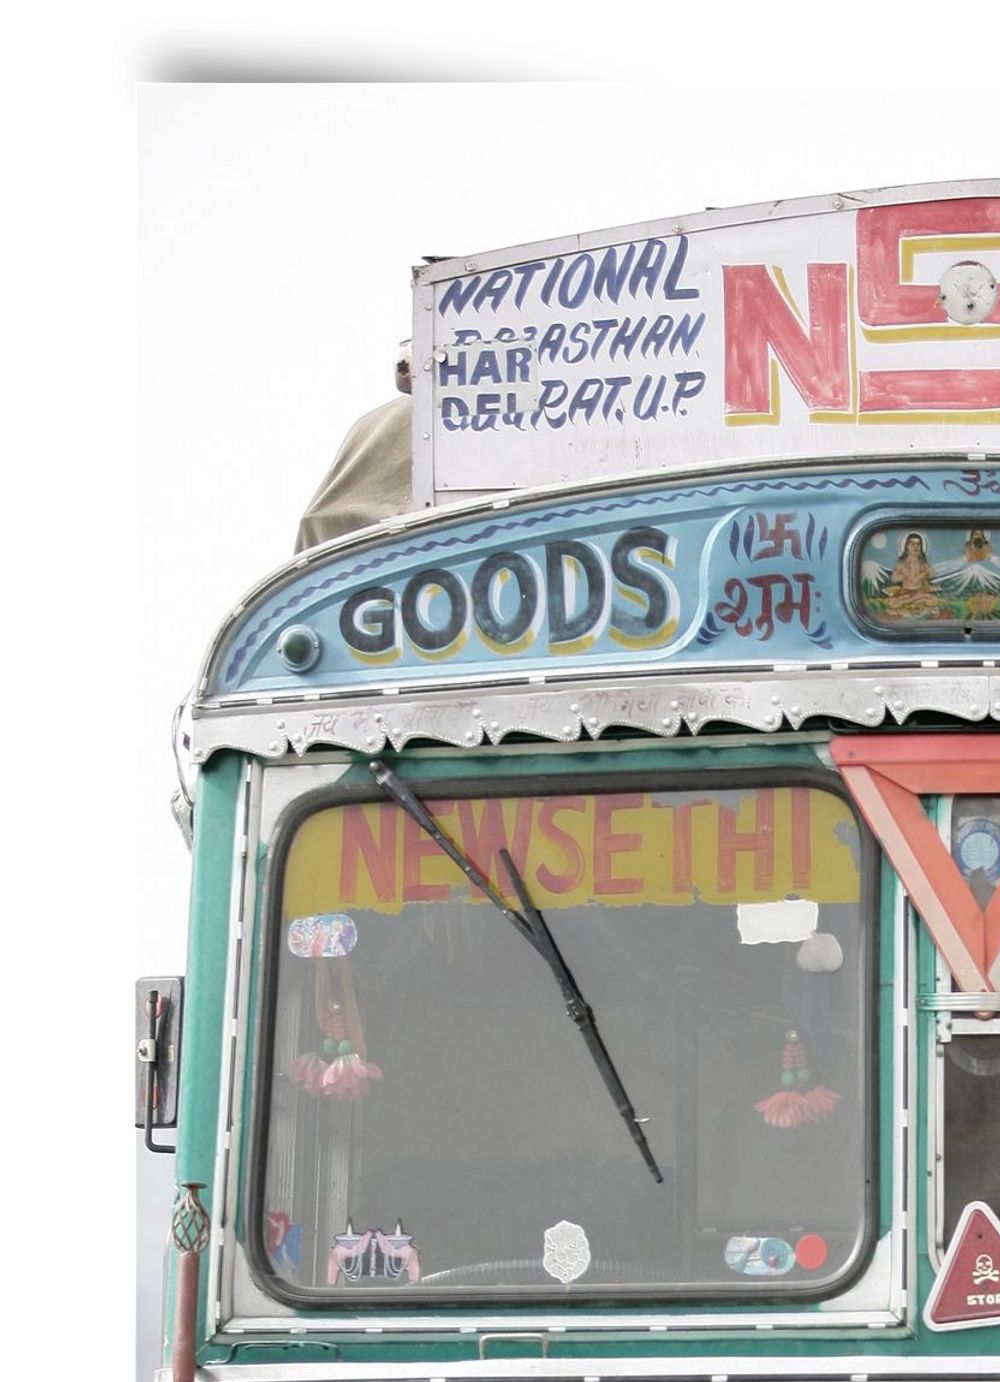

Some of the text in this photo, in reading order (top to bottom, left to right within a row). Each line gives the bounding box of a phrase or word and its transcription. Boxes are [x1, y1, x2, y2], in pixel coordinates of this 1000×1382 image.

[438, 234, 701, 318] NATIONAL
[439, 347, 533, 387] HAR
[338, 525, 681, 664] GOODS
